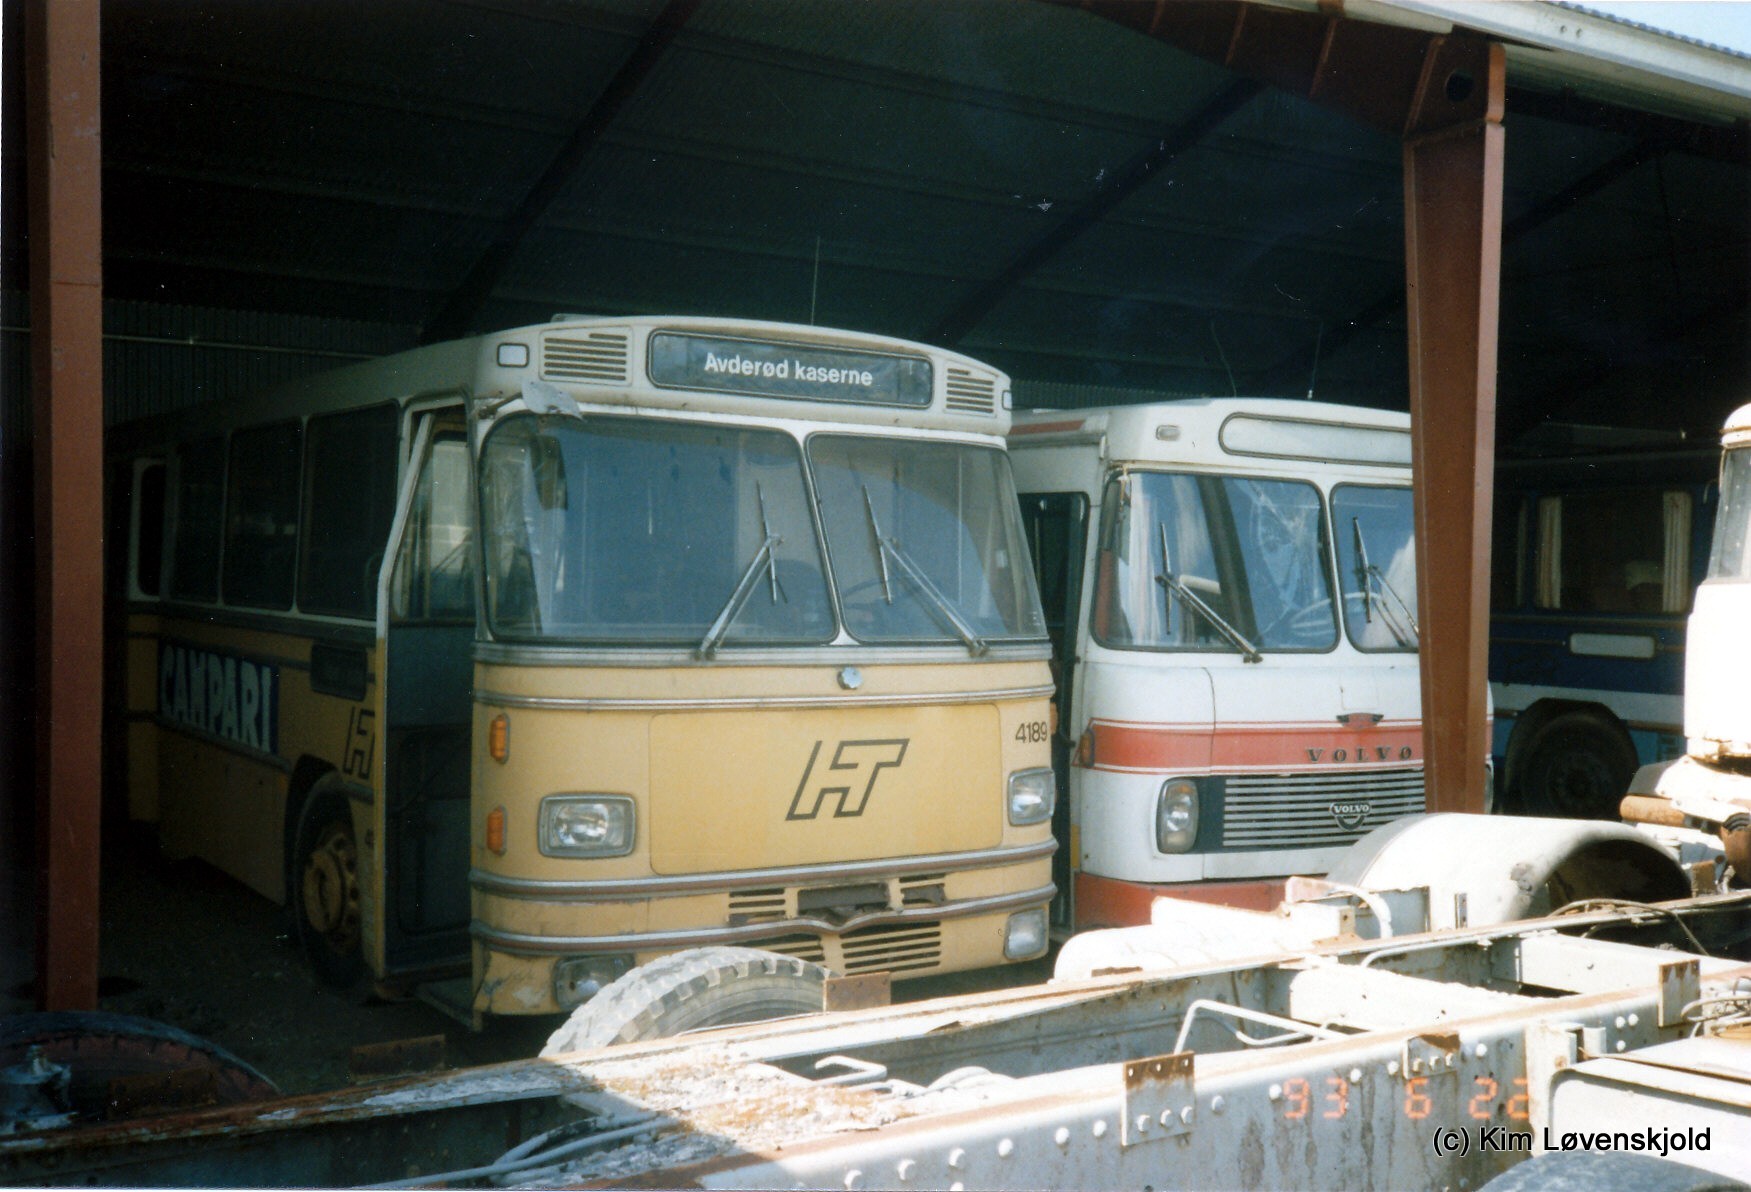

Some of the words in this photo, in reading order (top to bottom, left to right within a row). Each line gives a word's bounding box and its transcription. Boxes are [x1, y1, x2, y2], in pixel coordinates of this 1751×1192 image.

[704, 352, 789, 379] Avderød
[795, 362, 873, 386] kaserne
[160, 644, 272, 753] CAMPARI
[1015, 721, 1048, 743] 4189
[1305, 745, 1413, 762] VOLVO
[785, 737, 910, 821] HT
[1333, 803, 1370, 814] VOLVO
